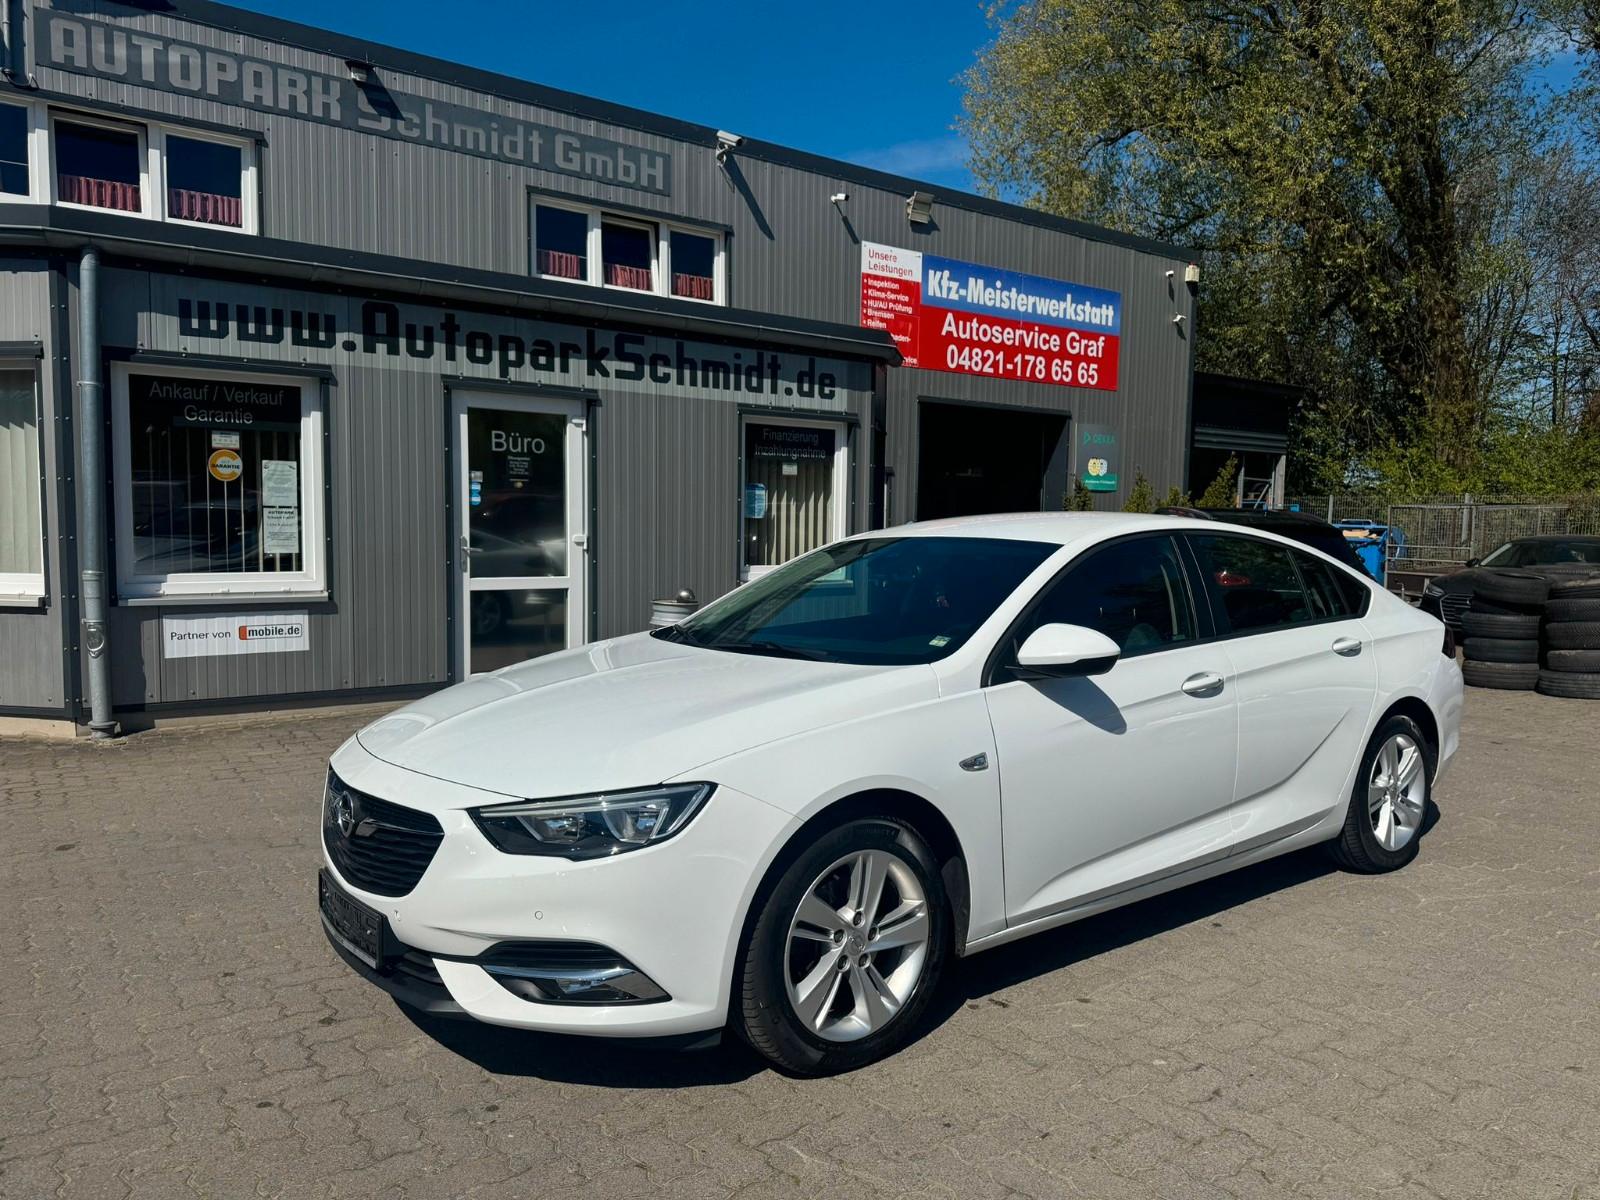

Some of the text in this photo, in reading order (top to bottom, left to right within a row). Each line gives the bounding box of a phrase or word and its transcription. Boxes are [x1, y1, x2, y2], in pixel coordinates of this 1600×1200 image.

[50, 17, 664, 190] AUTOPARK Schmidt GmbH
[868, 248, 897, 262] Unsere
[868, 260, 913, 277] Leistungen
[868, 278, 899, 290] Inspektion
[927, 269, 1114, 327] Kfz-Meisterwerkstatt
[867, 308, 895, 319] Bremsen
[941, 312, 1106, 359] Autoservice Graf
[178, 299, 836, 400] www.AutoparkSchmidt.de
[946, 343, 1098, 386] 04821-178 65 65
[149, 381, 285, 406] Ankauf / Verkauf
[184, 405, 254, 424] Garantie
[491, 430, 545, 454] Büro
[763, 429, 819, 445] Finanzierung
[754, 444, 825, 460] Inzahlungnahme
[170, 626, 300, 641] Partner von mobile.de
